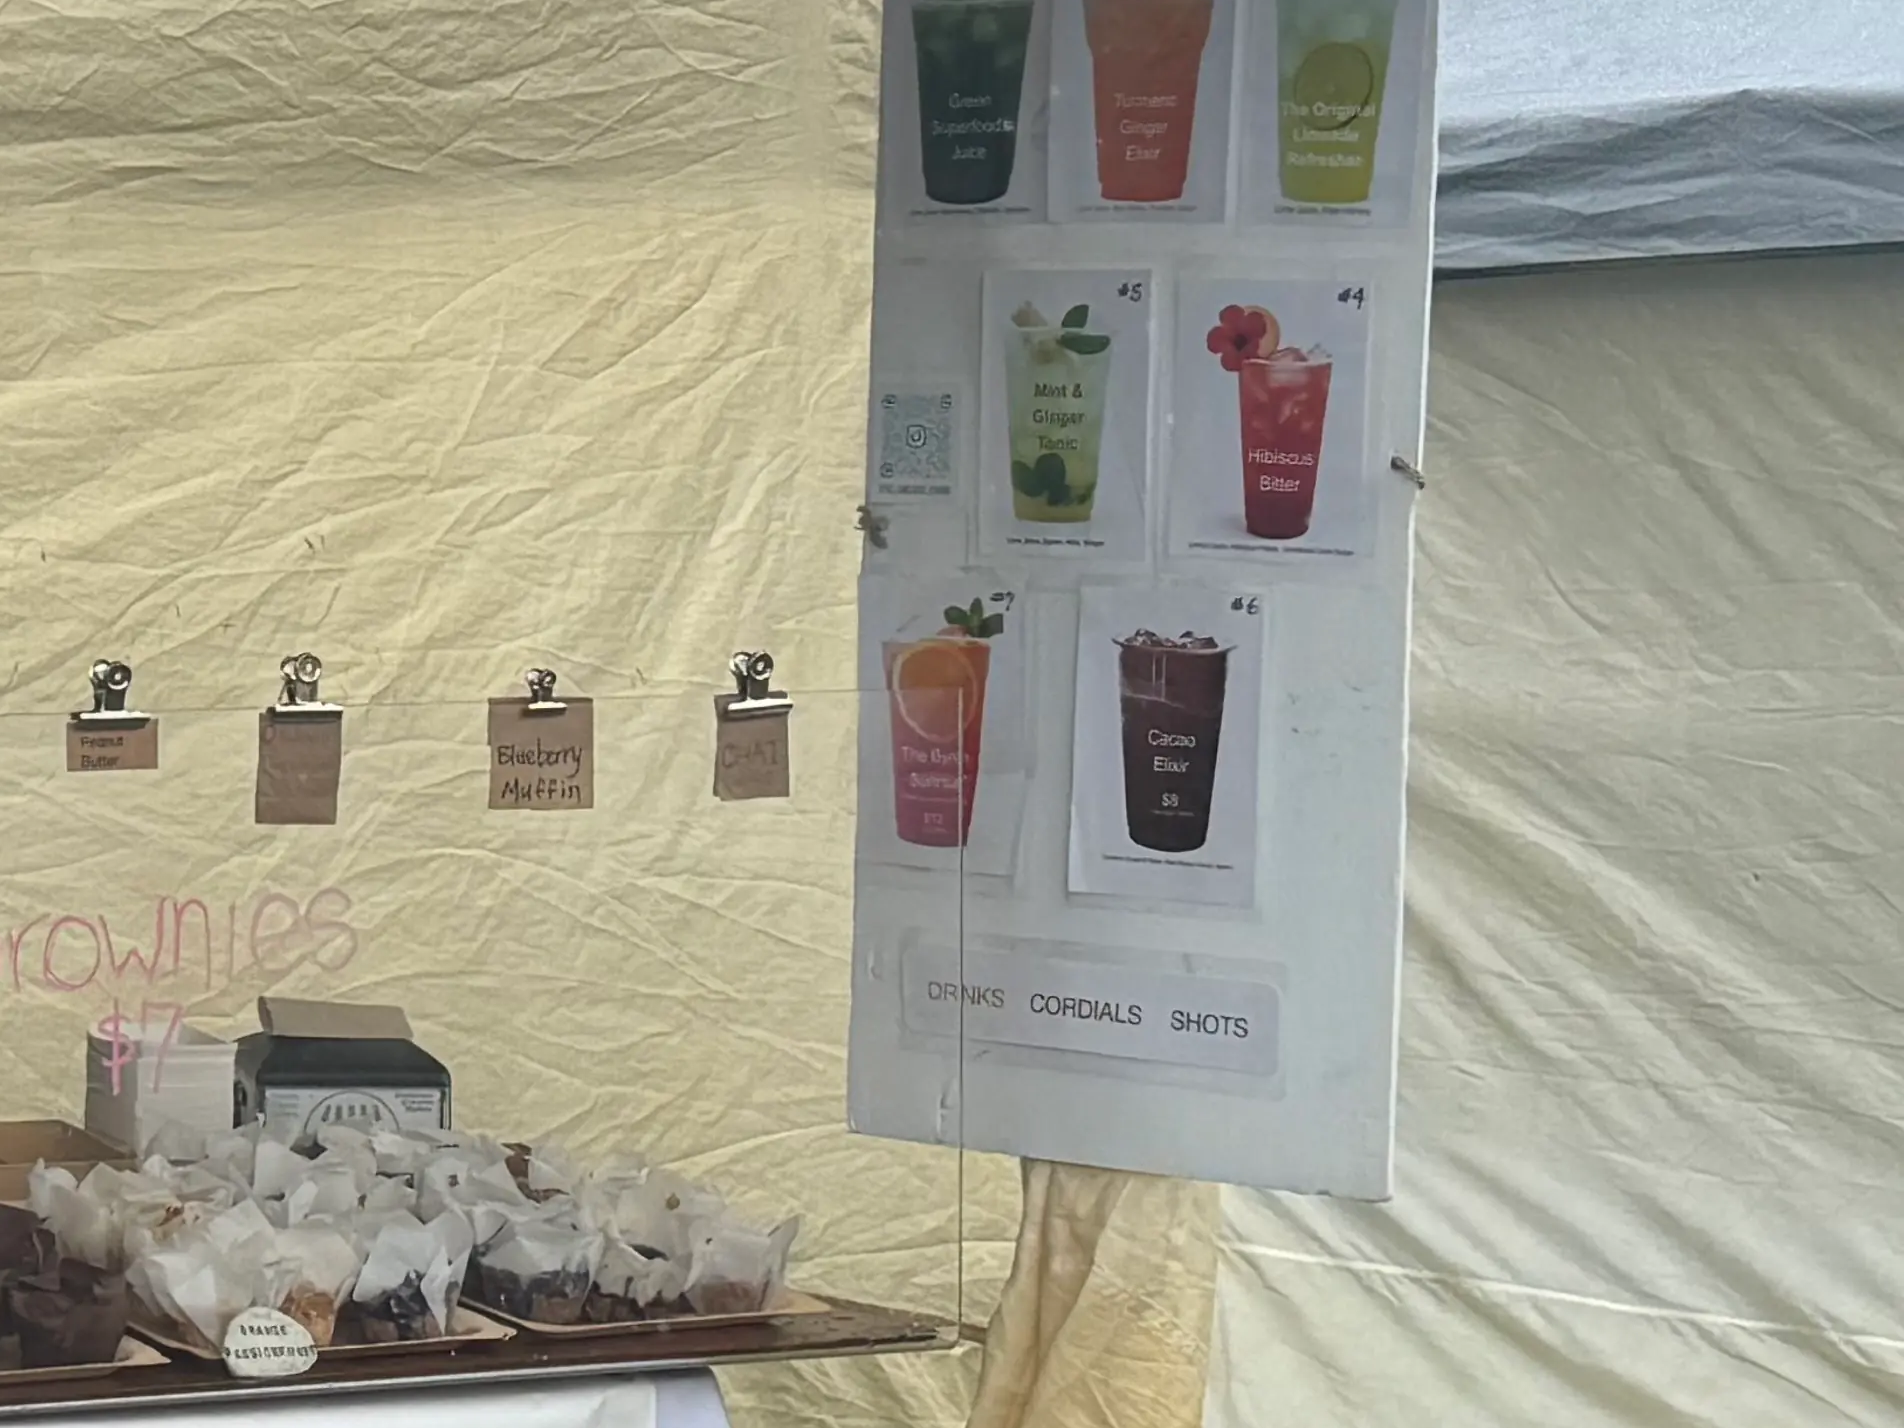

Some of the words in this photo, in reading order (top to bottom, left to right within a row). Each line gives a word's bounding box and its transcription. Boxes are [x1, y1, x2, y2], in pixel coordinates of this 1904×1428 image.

[1312, 101, 1375, 121] Original
[1118, 283, 1142, 302] #5
[1338, 288, 1365, 310] #4
[1033, 383, 1067, 398] Mint
[1072, 383, 1083, 398] &
[1032, 408, 1085, 428] Ginger
[1038, 436, 1078, 451] Tonic
[1248, 447, 1315, 467] Hibiscus
[1260, 475, 1300, 492] Bitter
[1230, 595, 1259, 615] #6
[1148, 730, 1196, 748] Cacao
[81, 755, 119, 768] Butter
[498, 738, 582, 778] Blueberry
[1153, 756, 1190, 773] Elixir
[501, 777, 581, 803] Muffin
[1030, 993, 1142, 1025] CORDIALS
[1171, 1010, 1248, 1038] SHOTS
[98, 998, 185, 1095] $7
